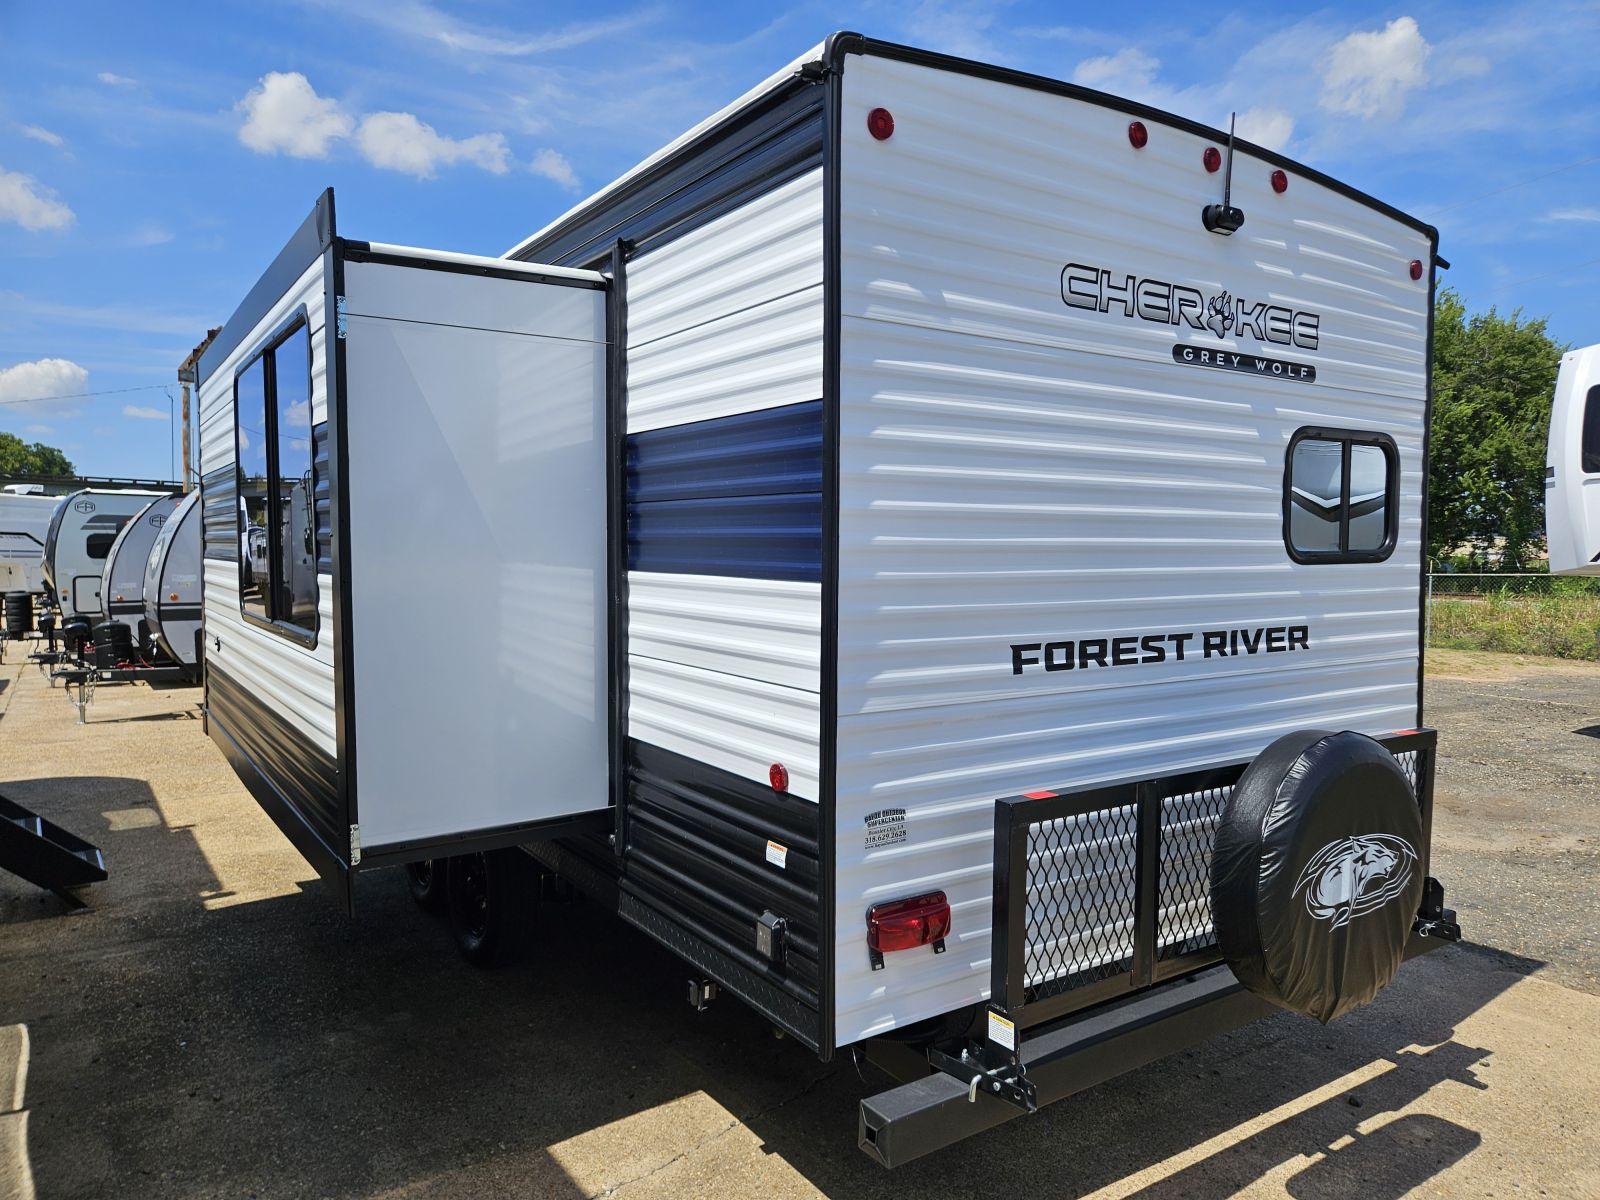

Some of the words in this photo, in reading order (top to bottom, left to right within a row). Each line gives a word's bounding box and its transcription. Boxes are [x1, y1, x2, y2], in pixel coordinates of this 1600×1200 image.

[1183, 348, 1240, 368] GREY
[1255, 358, 1309, 379] WOLF
[1010, 632, 1194, 675] FOREST
[1202, 625, 1310, 659] RIVER
[864, 830, 907, 844] 318.629.2628
